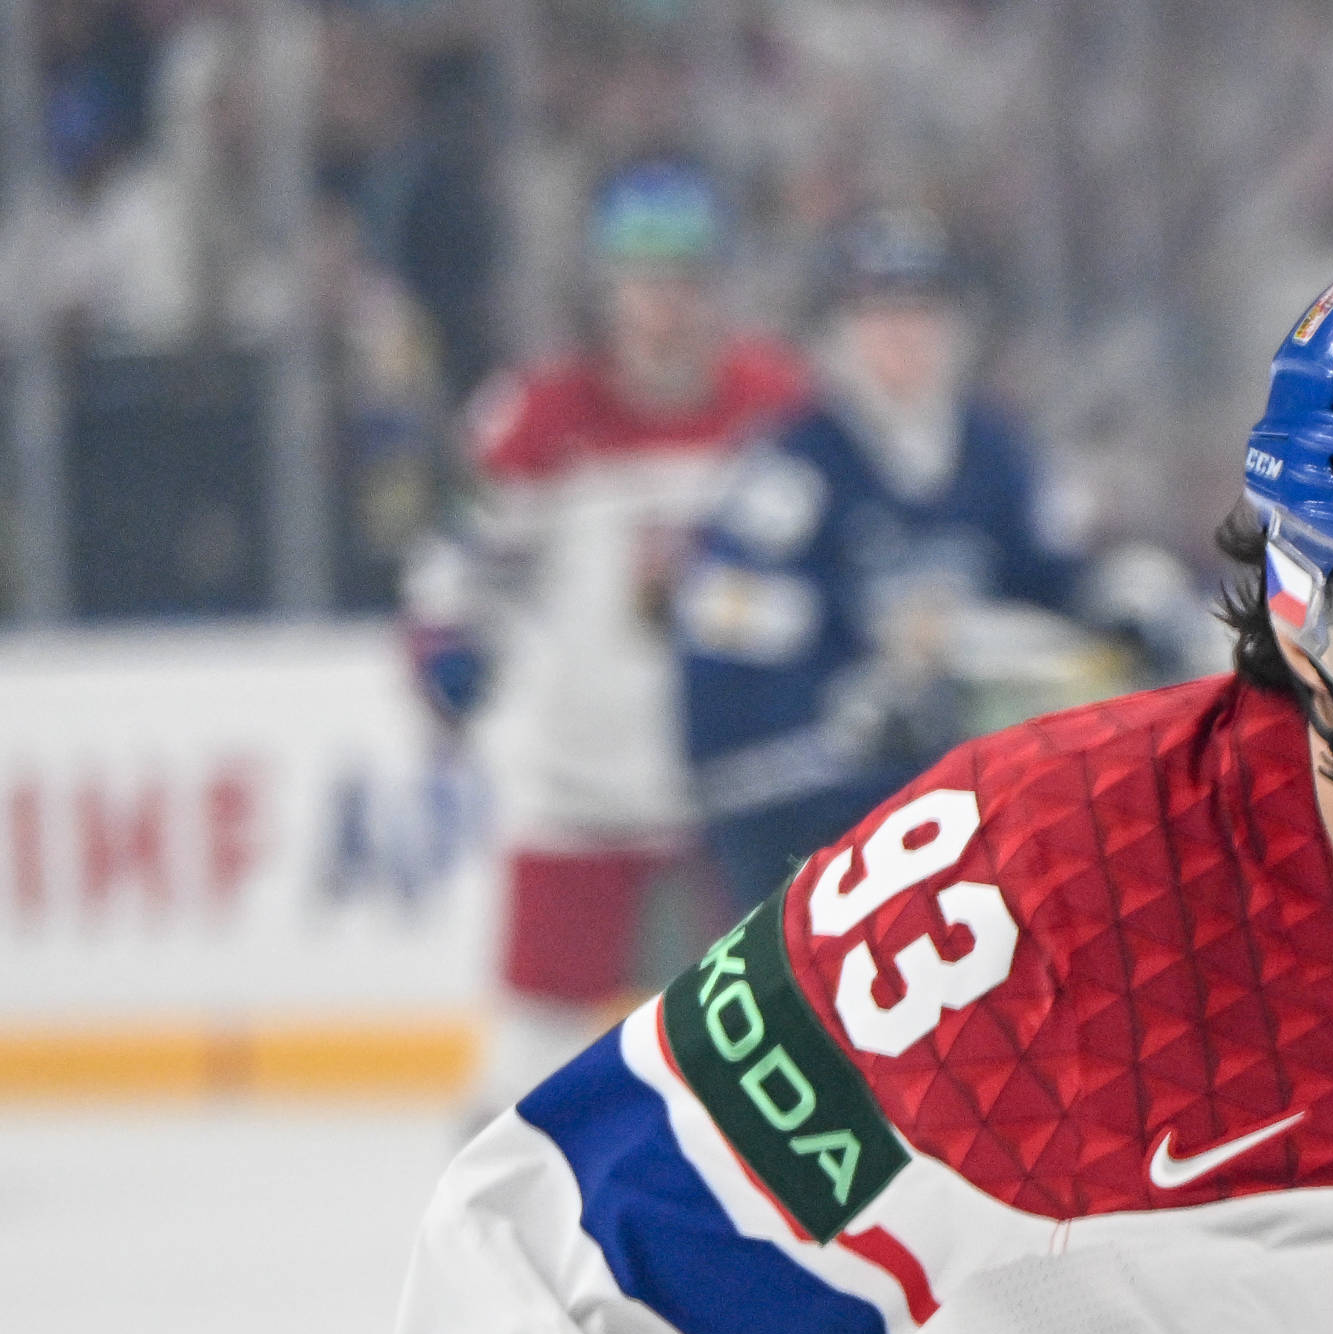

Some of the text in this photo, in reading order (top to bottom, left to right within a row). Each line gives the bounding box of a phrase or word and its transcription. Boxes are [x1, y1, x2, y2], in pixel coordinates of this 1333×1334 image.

[1246, 446, 1285, 480] CCM
[698, 908, 863, 1207] KODA
[808, 787, 1021, 1059] 93
